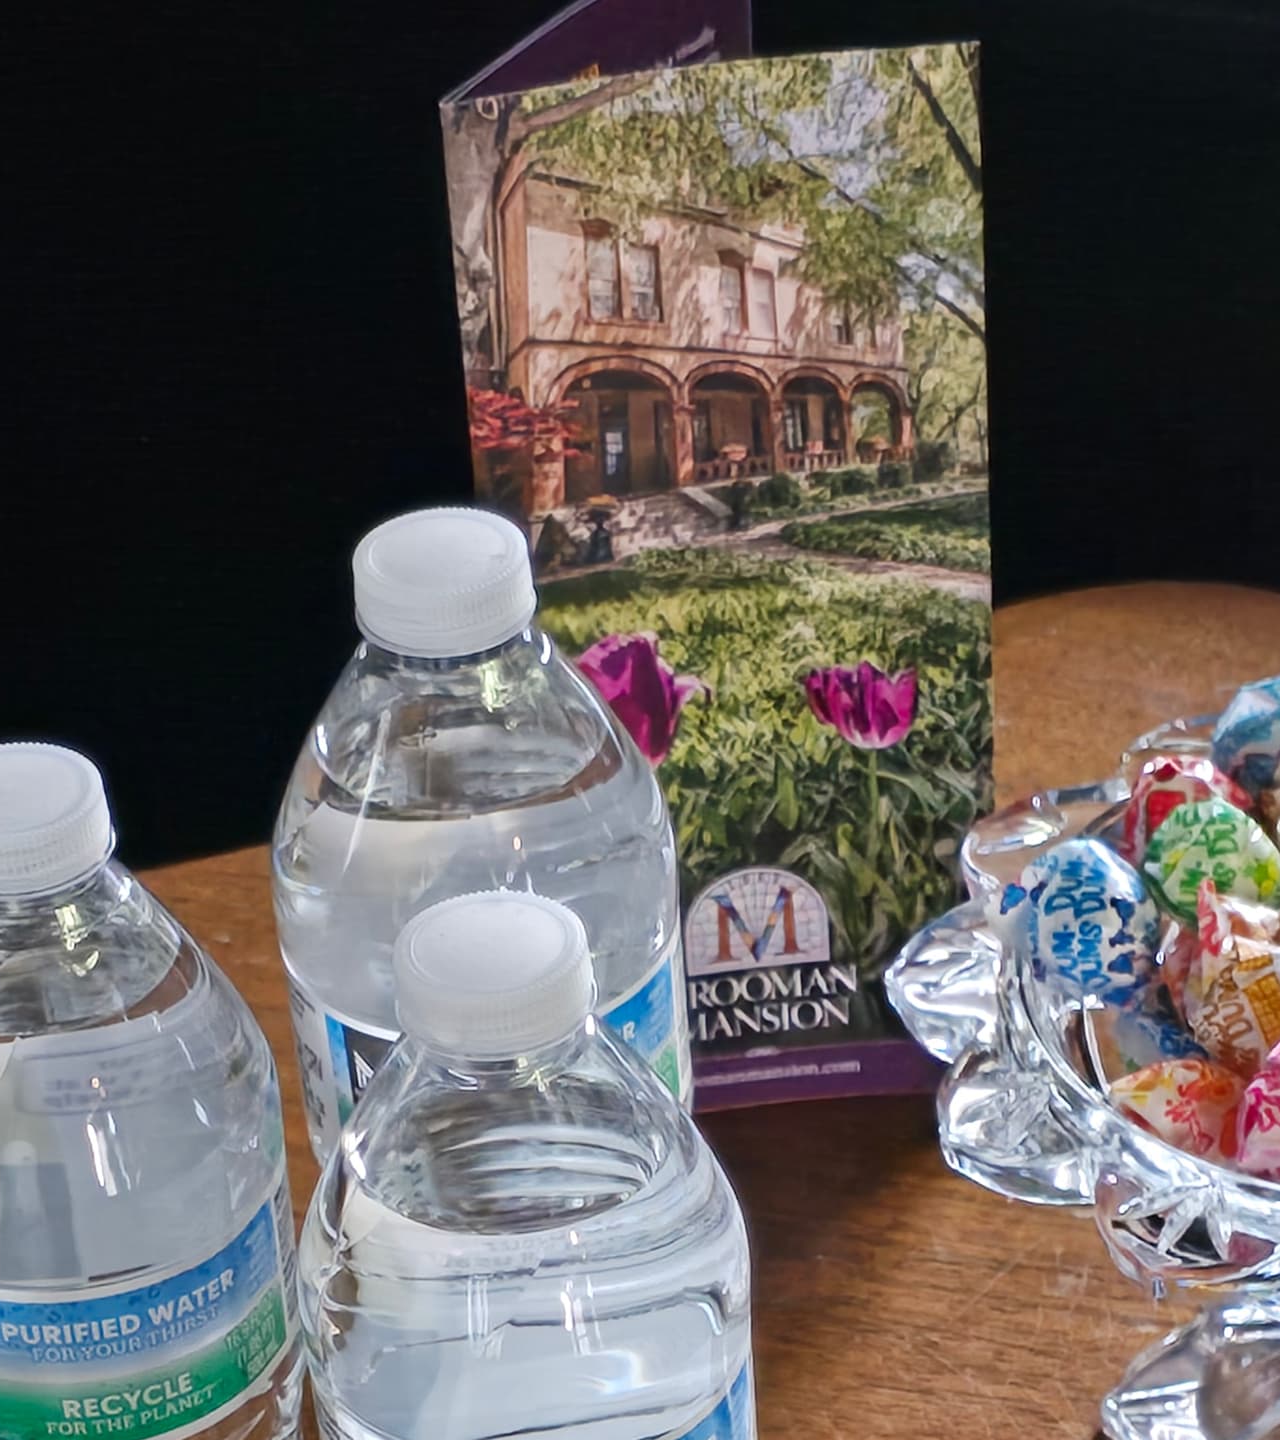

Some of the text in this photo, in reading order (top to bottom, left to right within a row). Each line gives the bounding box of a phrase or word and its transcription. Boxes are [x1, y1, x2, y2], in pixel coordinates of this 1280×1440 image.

[688, 963, 858, 1010] ROOMAN
[1, 1267, 235, 1346] PURIFIED WATER
[31, 1306, 219, 1364] FOR YOUR THIRST
[46, 1385, 215, 1436] FOR THE PLANET
[62, 1372, 193, 1419] RECYCLE
